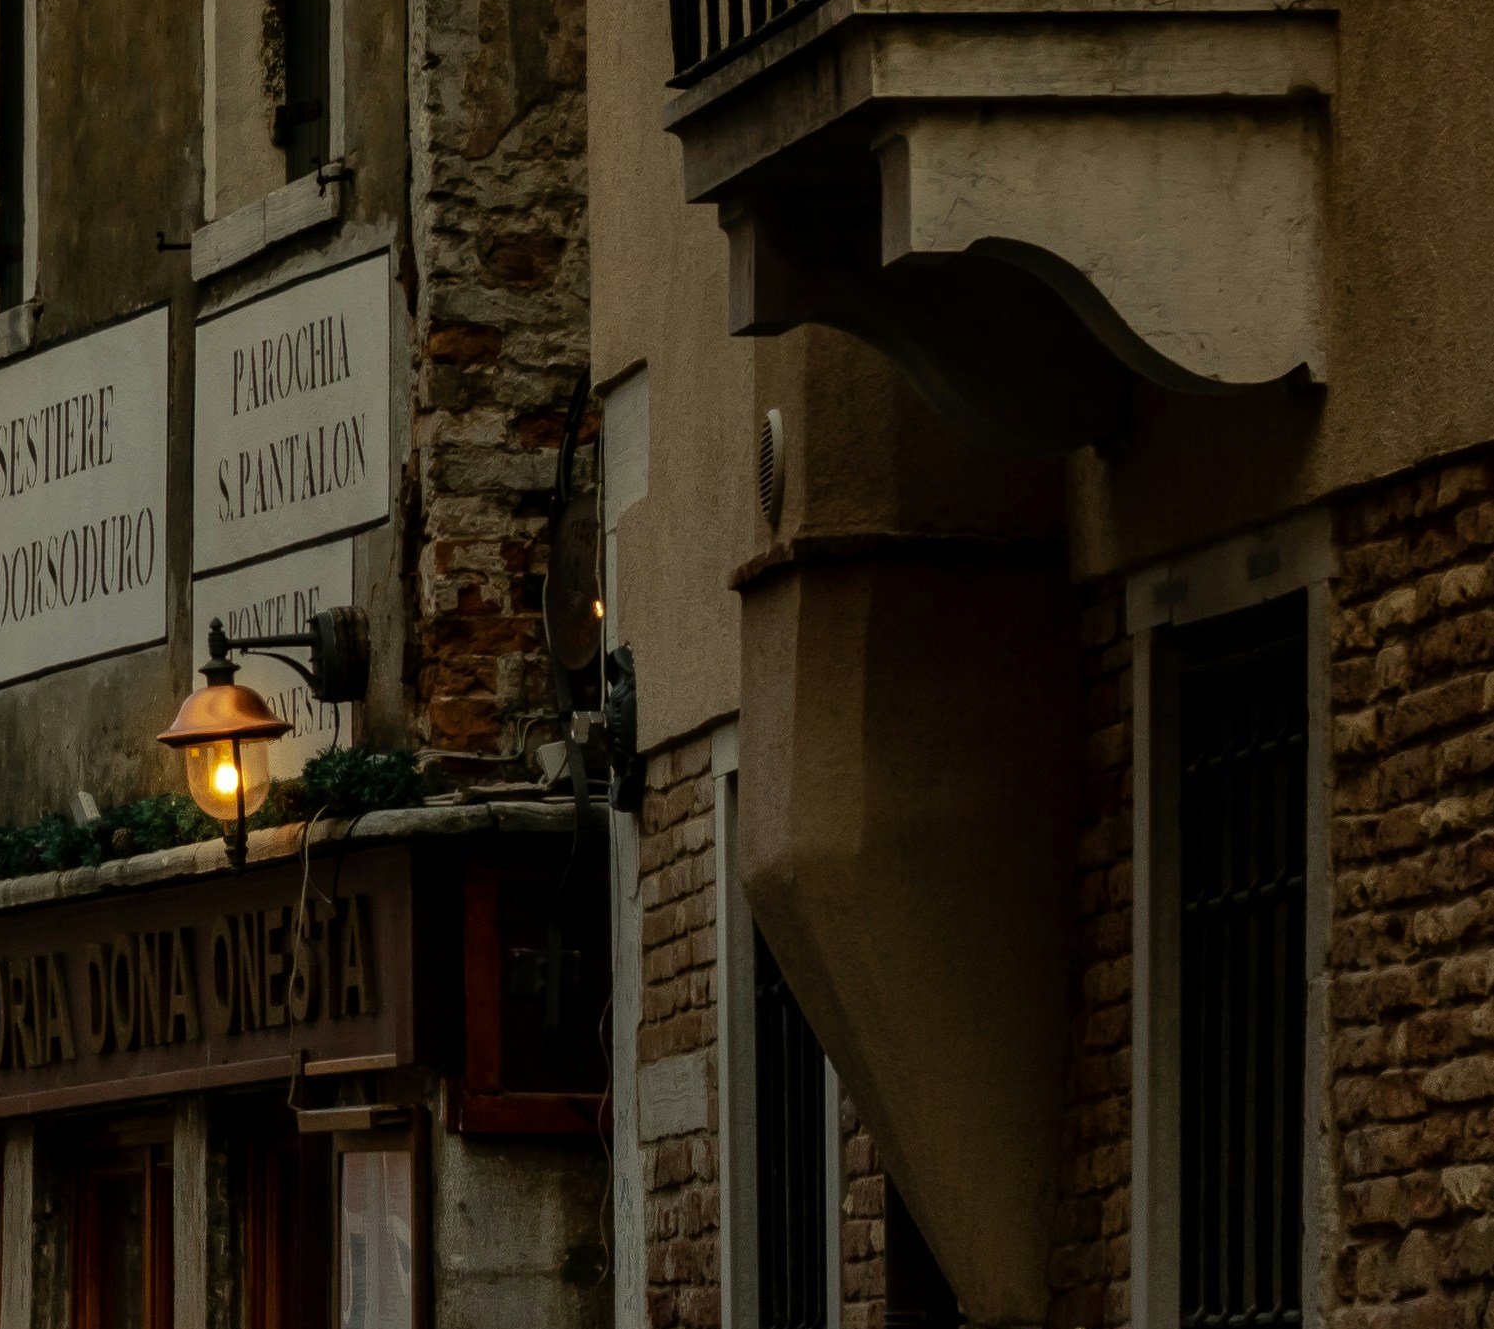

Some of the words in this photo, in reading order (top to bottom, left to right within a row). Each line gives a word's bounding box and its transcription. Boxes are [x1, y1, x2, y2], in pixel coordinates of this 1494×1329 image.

[232, 313, 351, 416] PAROCHIA
[84, 927, 202, 1054] DONA
[212, 894, 378, 1035] ONESTA
